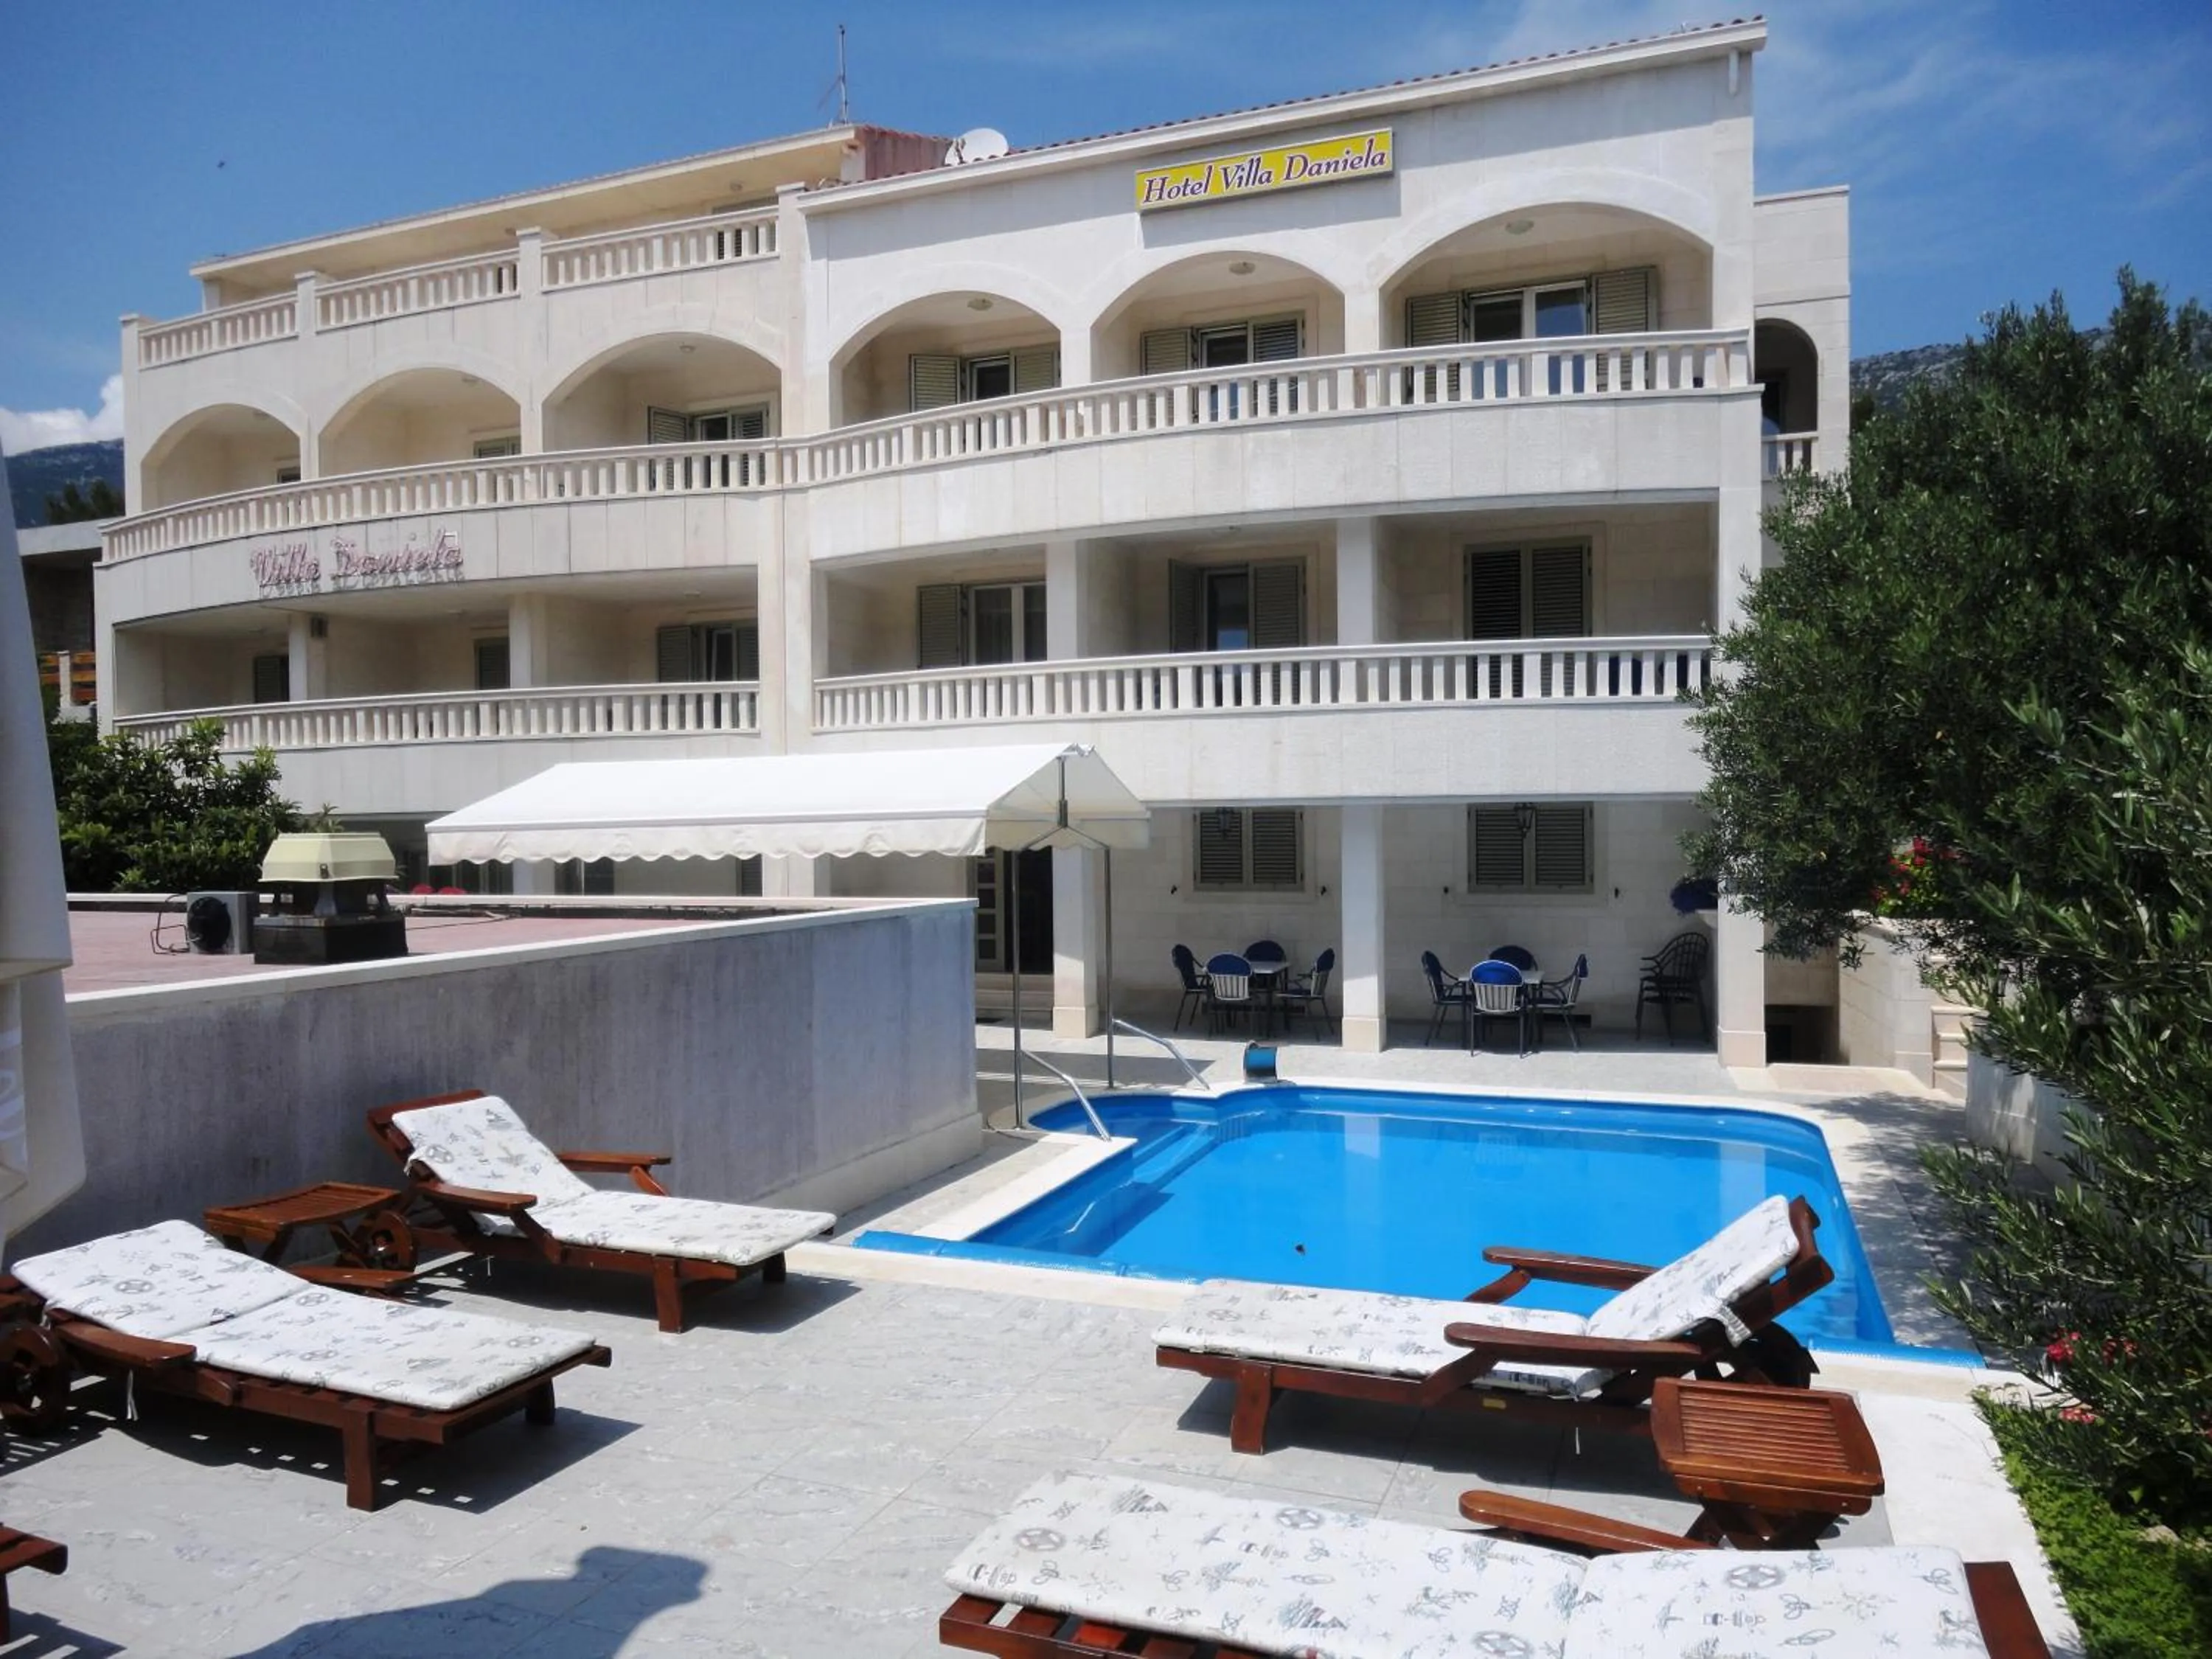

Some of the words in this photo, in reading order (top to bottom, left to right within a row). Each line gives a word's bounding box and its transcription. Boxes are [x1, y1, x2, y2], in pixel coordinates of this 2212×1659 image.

[1144, 165, 1214, 203] Hotel
[1220, 156, 1273, 191] Villa
[1283, 138, 1385, 181] Daniela
